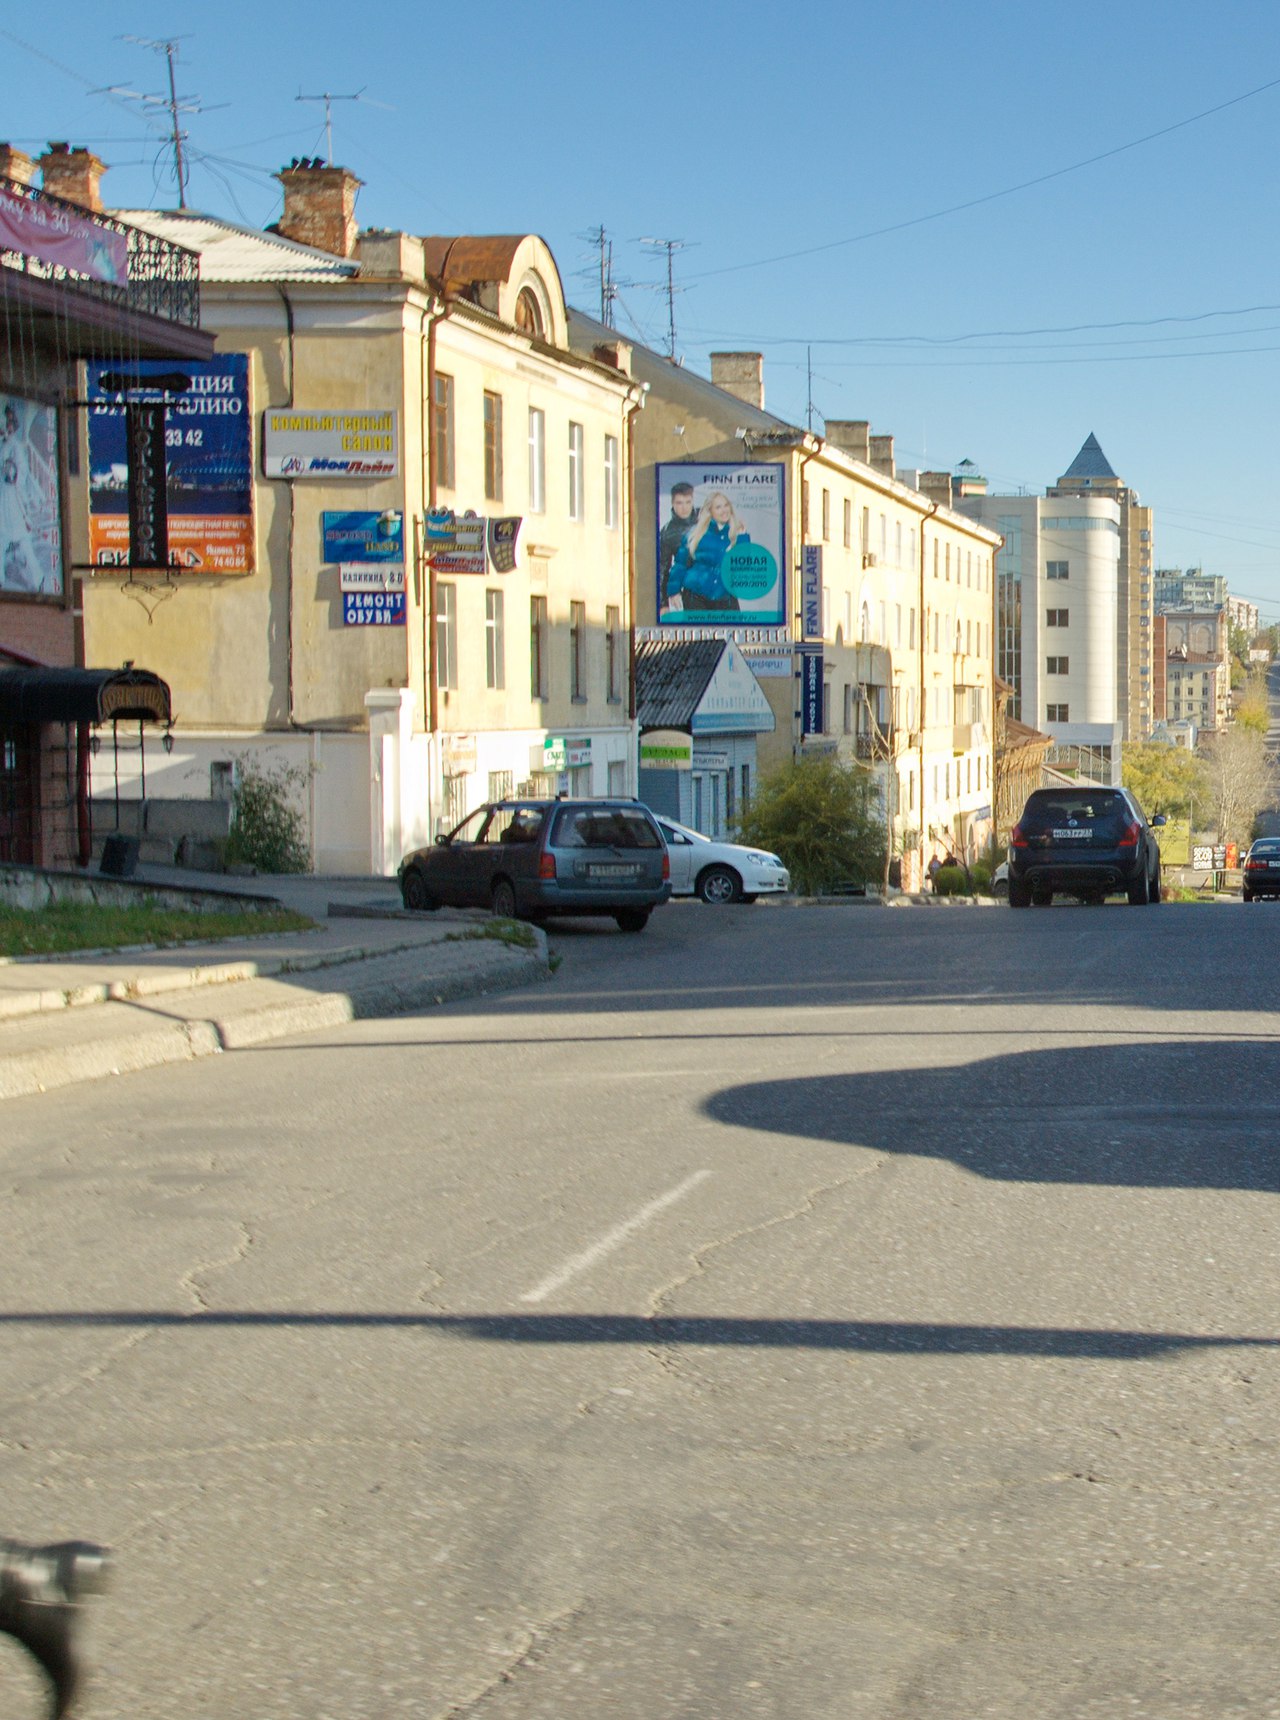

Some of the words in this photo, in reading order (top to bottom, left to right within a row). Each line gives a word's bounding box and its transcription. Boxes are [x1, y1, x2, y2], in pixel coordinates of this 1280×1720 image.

[185, 429, 203, 447] 42
[703, 474, 733, 484] FINN
[738, 474, 777, 484] FLARE
[730, 556, 768, 566] НОВАЯ
[806, 545, 818, 594] FLARE
[347, 593, 402, 608] РЕМОНТ
[347, 609, 392, 624] ОБУВИ
[806, 600, 818, 635] FINN
